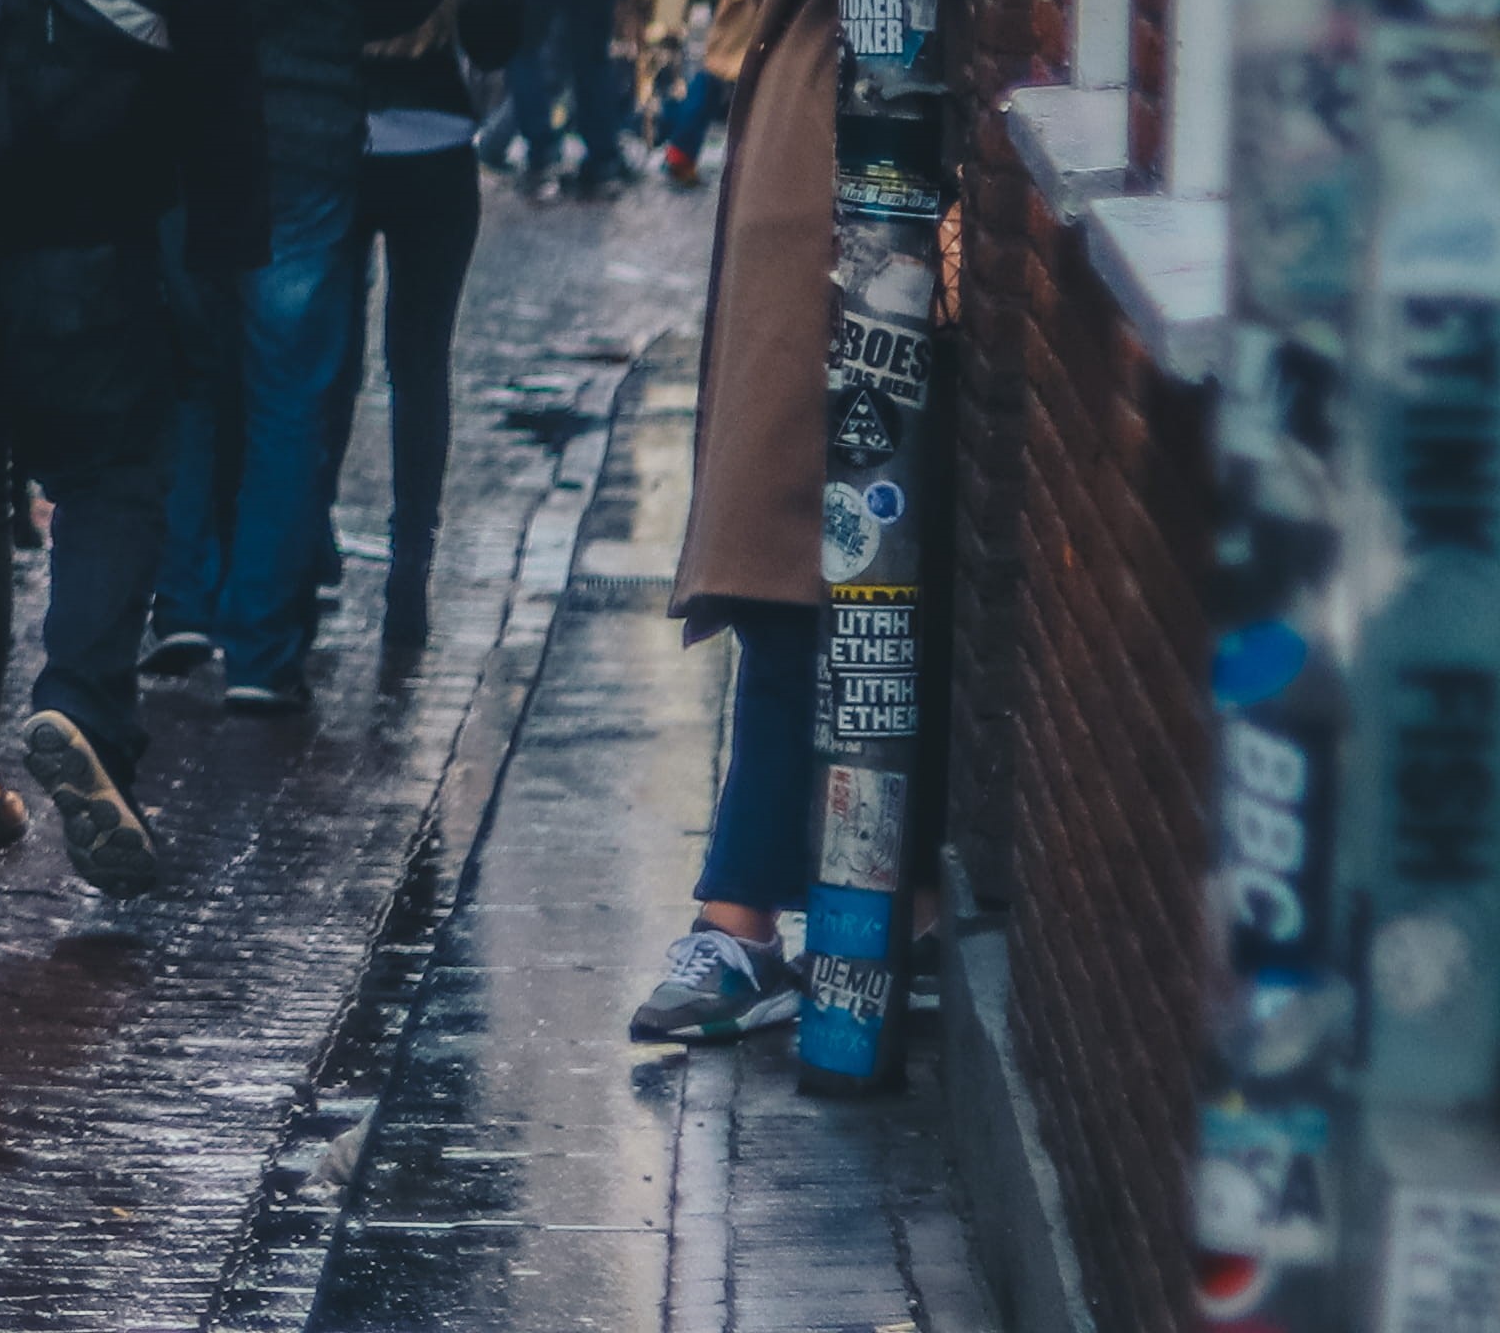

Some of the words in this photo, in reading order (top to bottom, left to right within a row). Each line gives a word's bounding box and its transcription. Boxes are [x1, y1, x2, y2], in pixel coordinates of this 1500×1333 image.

[837, 609, 910, 636] UTAH
[831, 636, 916, 664] ETHER
[844, 677, 915, 704] UTAH
[837, 704, 919, 731] ETHER
[1222, 719, 1306, 945] BBC
